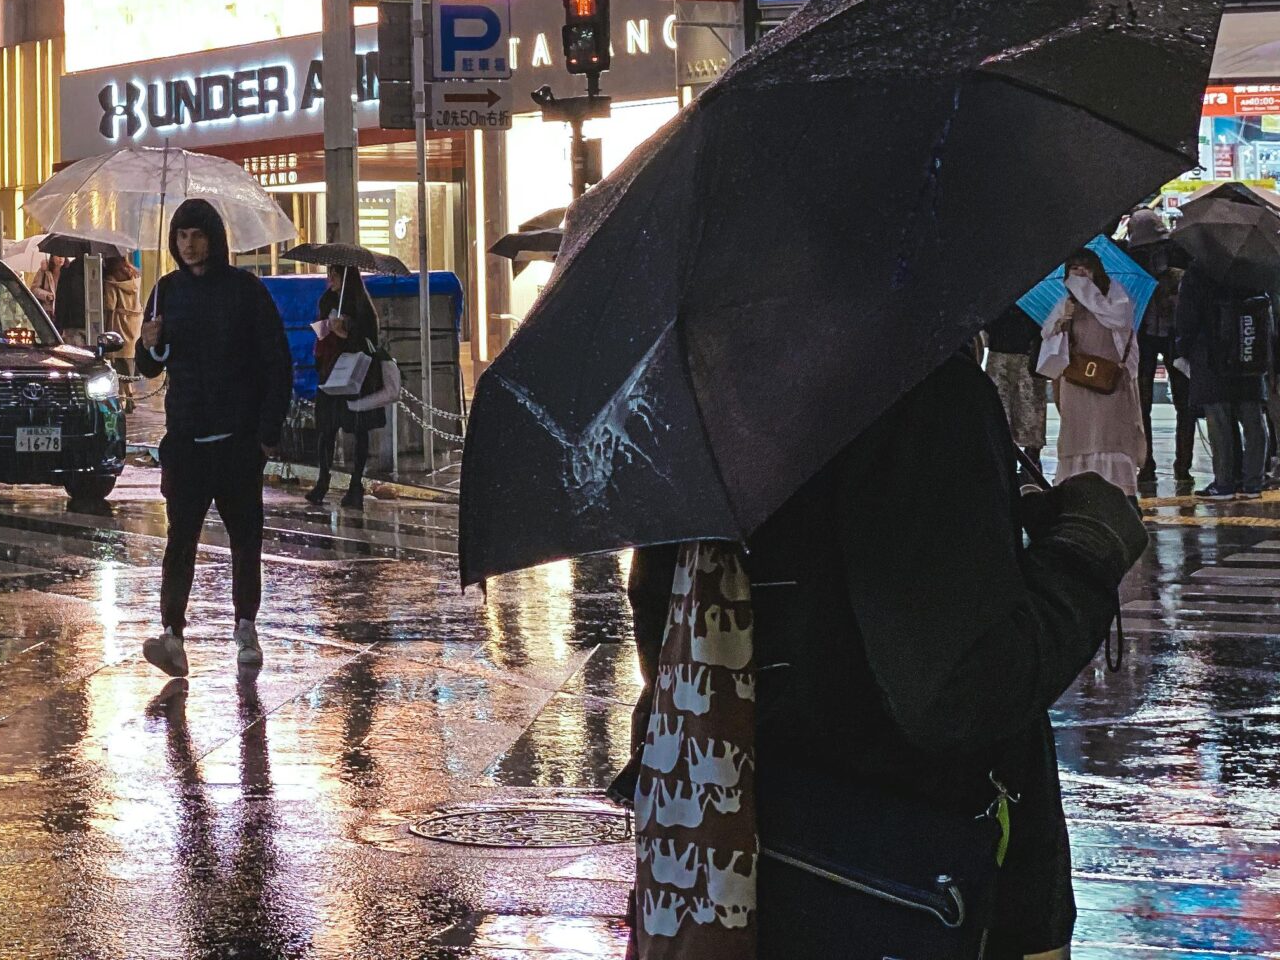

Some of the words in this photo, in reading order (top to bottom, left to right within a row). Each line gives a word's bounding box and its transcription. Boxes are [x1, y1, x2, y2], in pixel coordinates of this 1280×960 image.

[440, 5, 502, 72] P
[147, 65, 290, 128] UNDER
[436, 109, 510, 127] この先50m右折
[27, 436, 60, 451] 16-78
